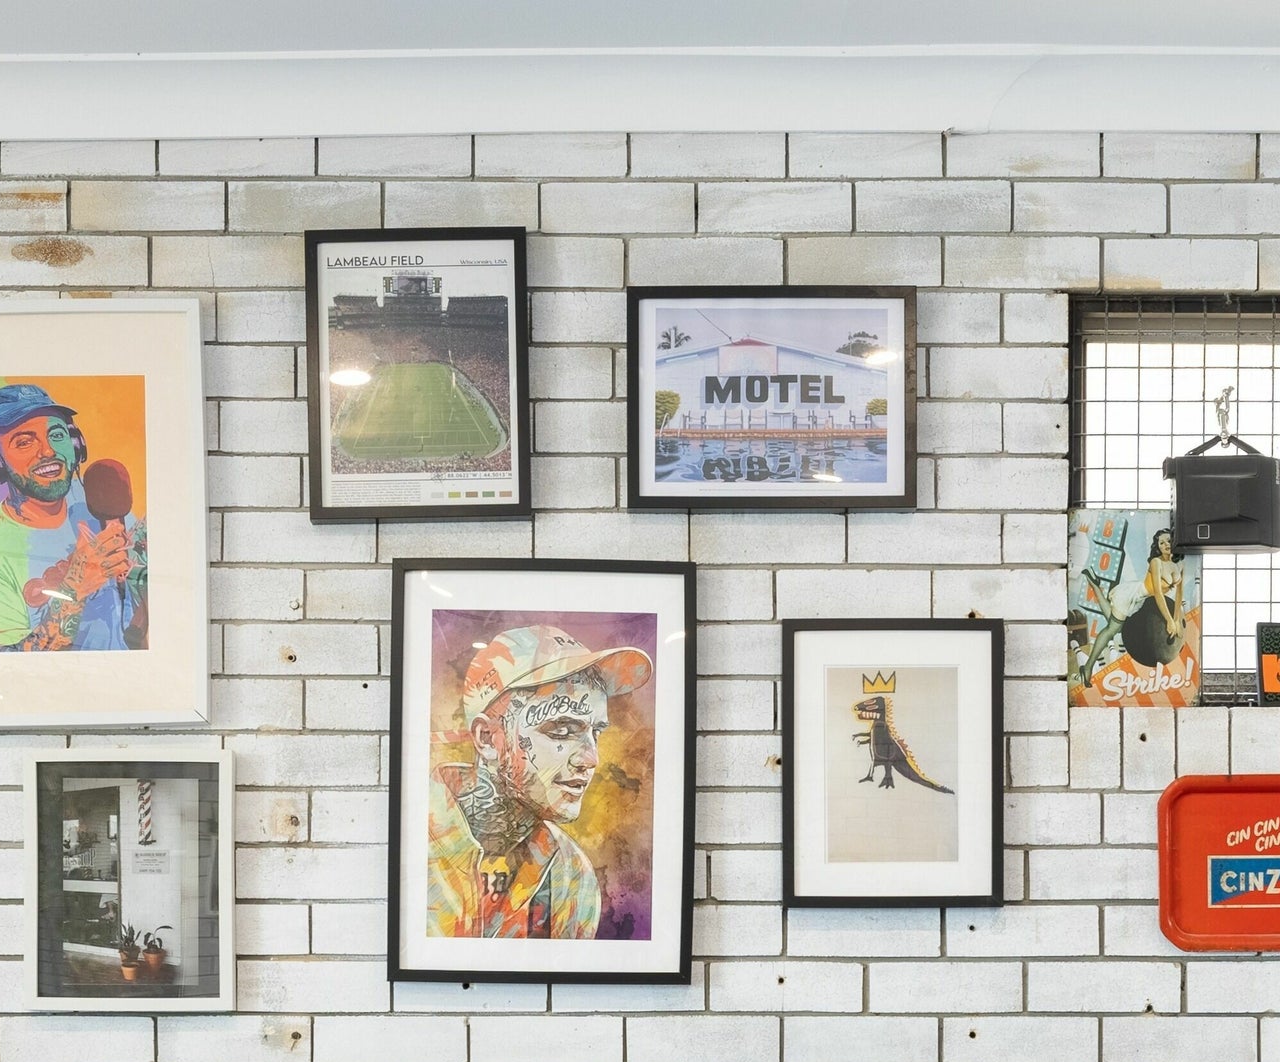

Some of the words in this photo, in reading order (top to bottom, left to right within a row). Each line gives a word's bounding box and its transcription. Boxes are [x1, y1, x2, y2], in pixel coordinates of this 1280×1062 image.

[327, 256, 387, 267] LAMBEAU
[391, 255, 424, 266] FIELD
[705, 374, 846, 404] MOTEL
[1103, 656, 1194, 701] Strike!
[1226, 826, 1251, 847] CIN
